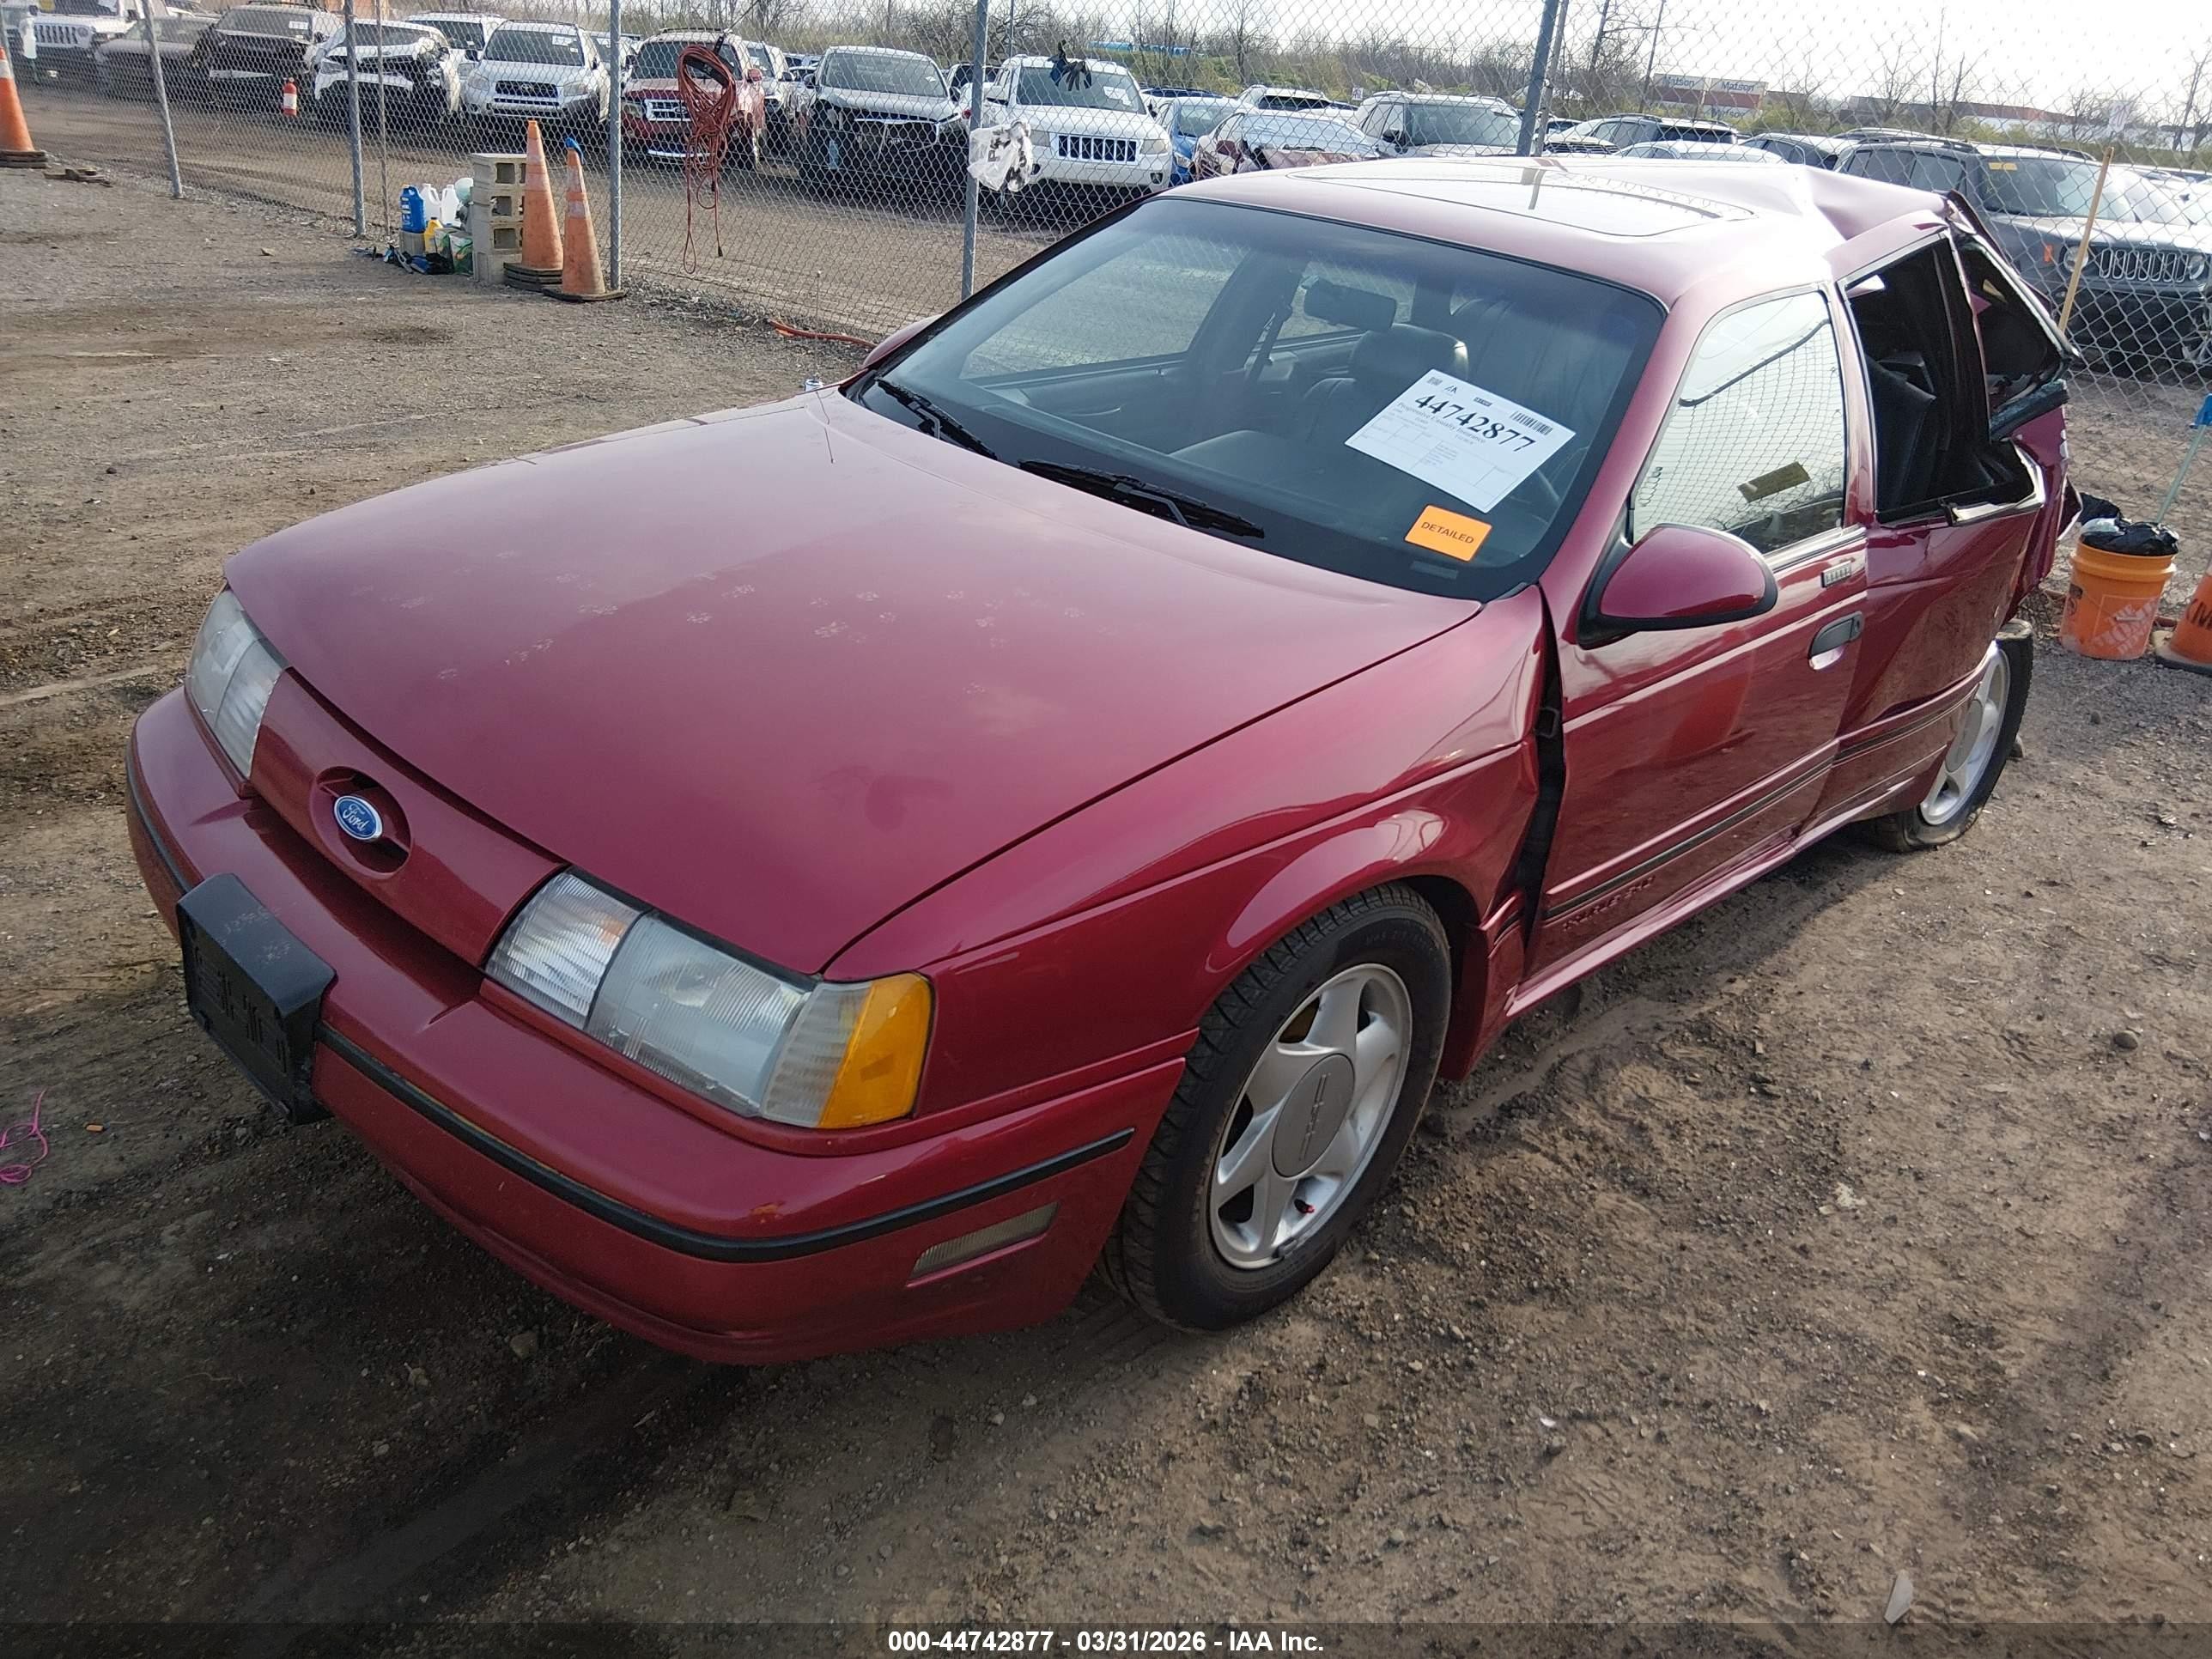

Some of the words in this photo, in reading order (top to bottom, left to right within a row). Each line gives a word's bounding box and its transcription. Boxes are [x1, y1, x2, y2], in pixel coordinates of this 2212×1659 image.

[1662, 76, 1696, 88] Matson
[1721, 81, 1755, 92] Matson
[1414, 394, 1537, 453] 44742877
[1420, 520, 1475, 544] DETAILED
[343, 803, 370, 831] Ford
